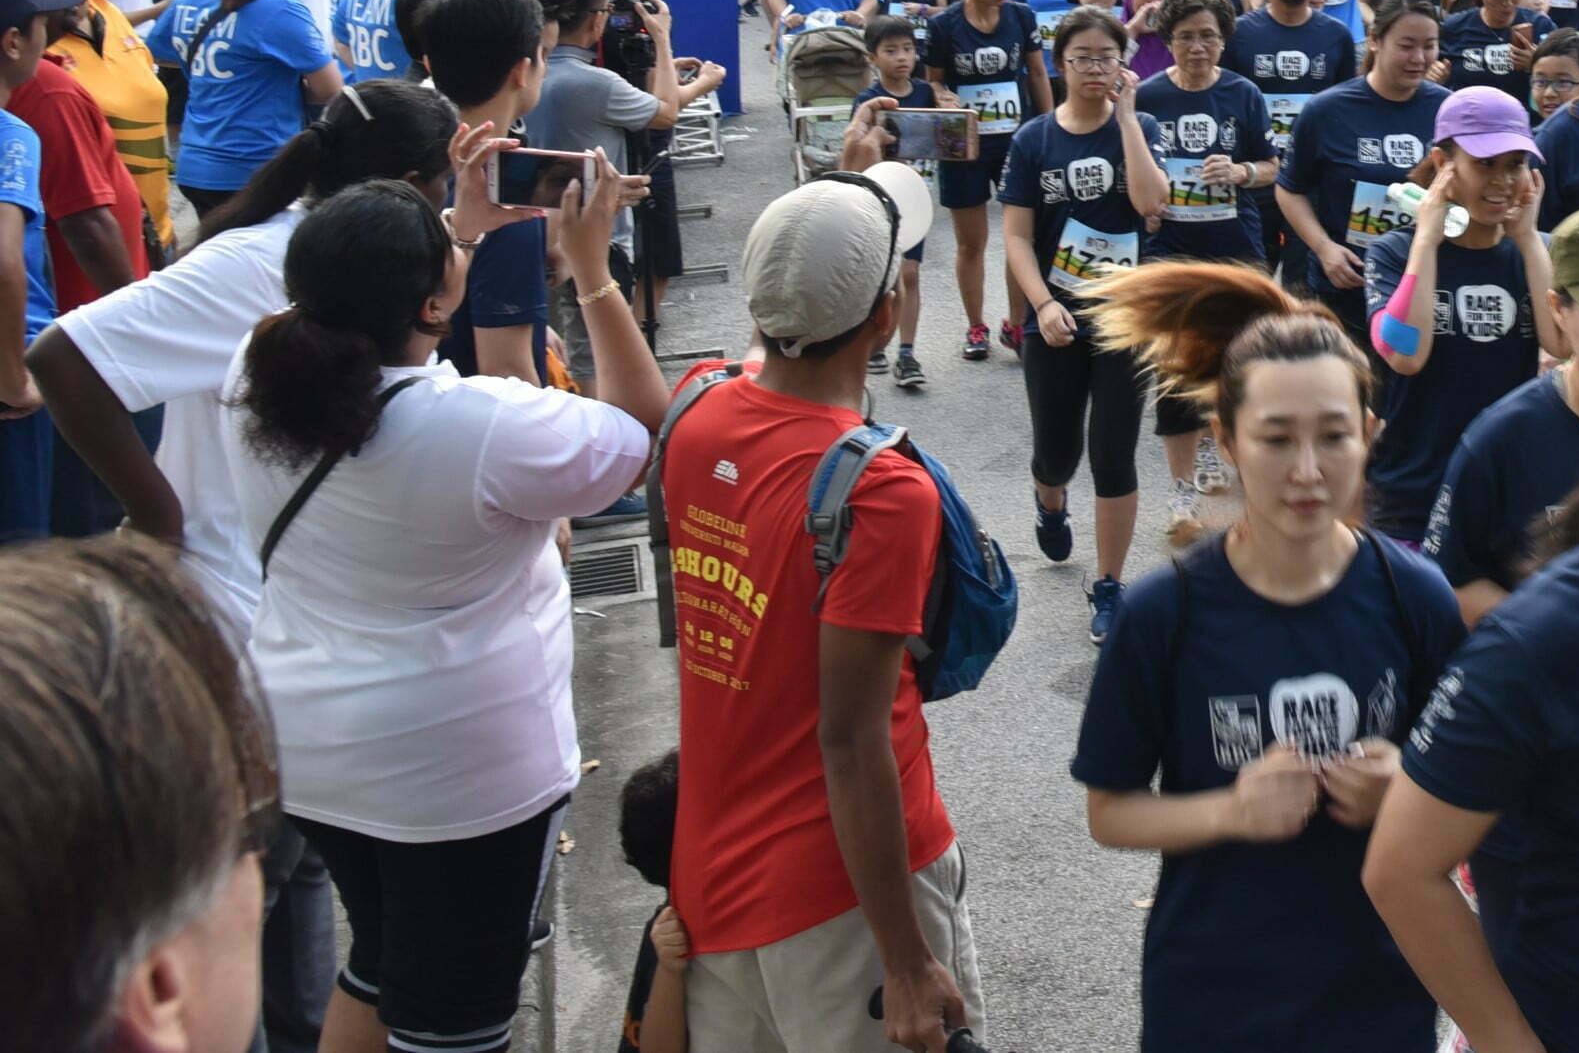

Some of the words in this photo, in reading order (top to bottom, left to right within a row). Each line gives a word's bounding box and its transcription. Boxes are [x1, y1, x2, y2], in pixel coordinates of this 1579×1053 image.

[1183, 121, 1210, 132] RACE
[1183, 139, 1210, 149] KIDS
[1389, 140, 1415, 152] RACE
[1074, 163, 1105, 180] RACE
[1076, 185, 1106, 200] KIDS
[1464, 294, 1503, 313] RACE
[1465, 312, 1482, 322] FOR
[1486, 312, 1504, 322] THE
[1464, 322, 1504, 338] KIDS
